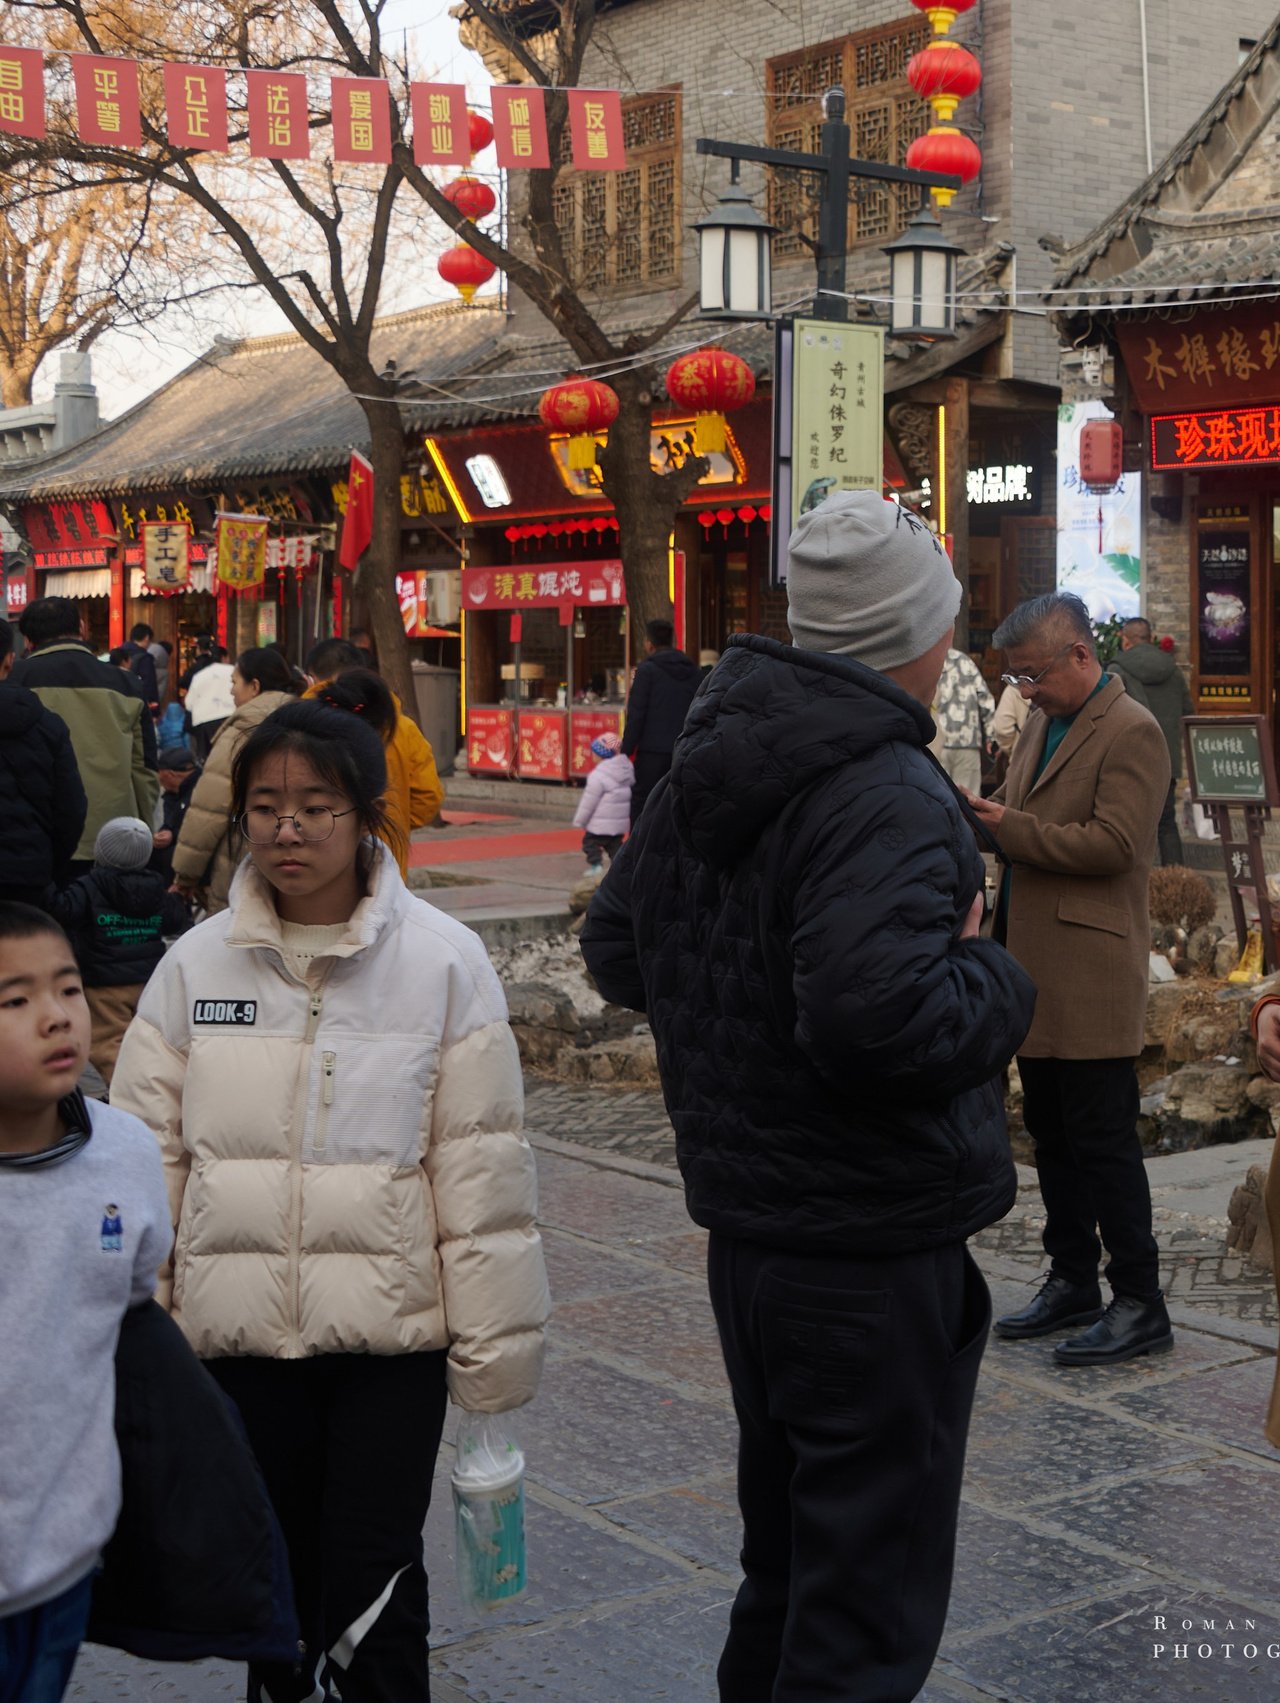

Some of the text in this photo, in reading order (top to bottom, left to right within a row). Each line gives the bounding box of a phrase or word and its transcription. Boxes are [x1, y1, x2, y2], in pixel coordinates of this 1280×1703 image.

[0, 59, 24, 122] 自由
[93, 68, 120, 132] 平等
[185, 75, 210, 137] 公正
[266, 84, 291, 146] 法治
[349, 90, 373, 151] 爱国
[429, 94, 453, 154] 敬业
[507, 97, 532, 157] 诚信
[584, 101, 608, 159] 友善
[829, 361, 848, 463] 奇幻侏罗纪
[856, 362, 866, 408] 青州古城
[810, 432, 820, 469] 欢迎您
[154, 525, 179, 583] 手工皂
[494, 570, 583, 600] 清真馄饨
[195, 1002, 255, 1022] LOOK-9
